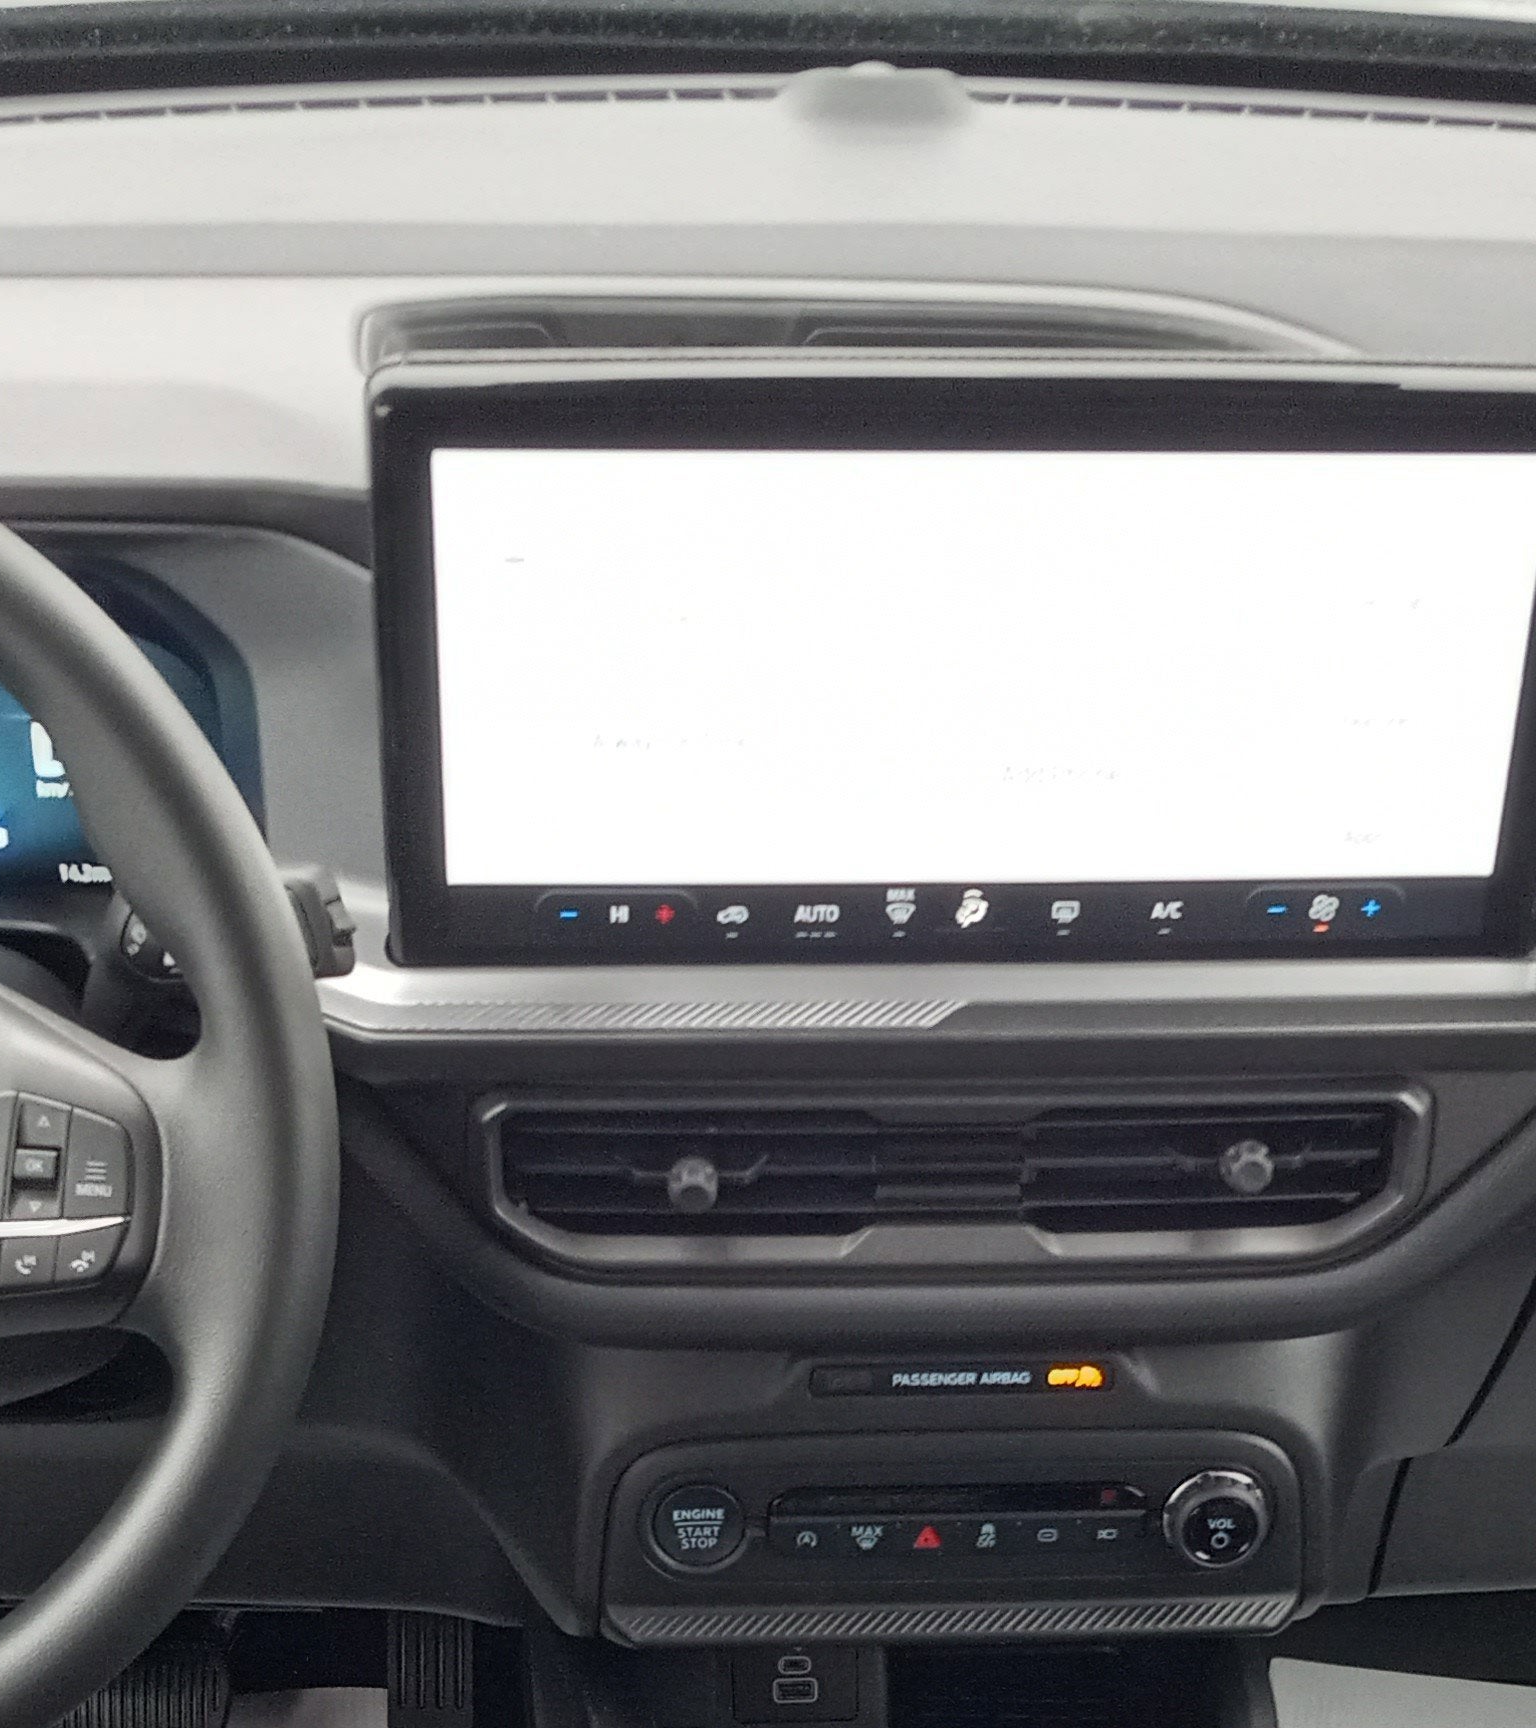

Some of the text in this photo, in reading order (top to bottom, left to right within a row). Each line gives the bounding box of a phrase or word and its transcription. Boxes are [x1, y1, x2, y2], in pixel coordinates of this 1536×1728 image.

[609, 905, 630, 923] HI
[794, 904, 840, 923] AUTO
[1150, 901, 1184, 920] A/C
[892, 1371, 977, 1387] PASSENGER
[979, 1371, 1032, 1385] AIRBAG
[672, 1508, 725, 1521] ENGINE
[1207, 1518, 1237, 1530] VOL
[677, 1526, 720, 1538] START
[851, 1525, 884, 1537] MAX
[681, 1537, 718, 1549] STOP
